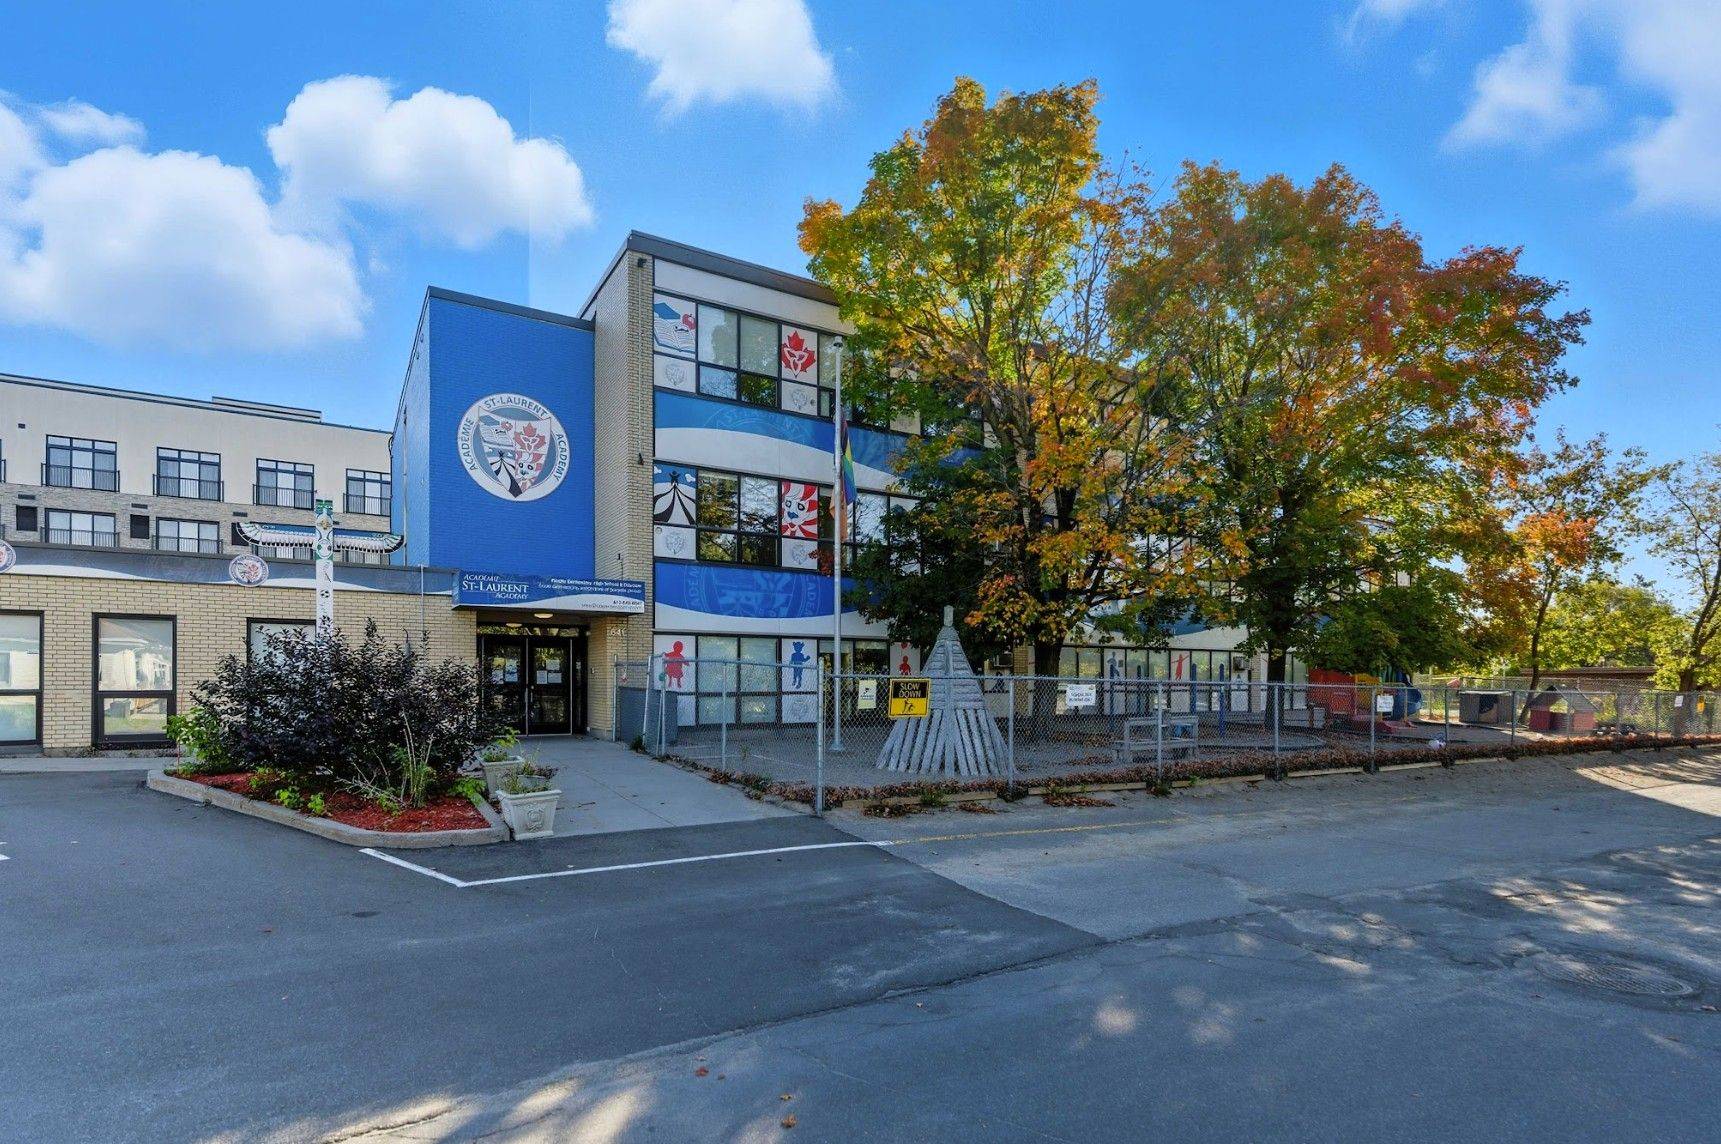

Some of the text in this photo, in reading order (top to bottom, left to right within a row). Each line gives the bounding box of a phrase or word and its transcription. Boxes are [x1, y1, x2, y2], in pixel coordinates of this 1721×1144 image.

[484, 396, 549, 418] ST-LAURENT
[555, 433, 568, 481] ACADEMY
[462, 580, 529, 593] ST-LAURENT
[900, 682, 920, 690] SLOW
[899, 690, 921, 698] DOWN
